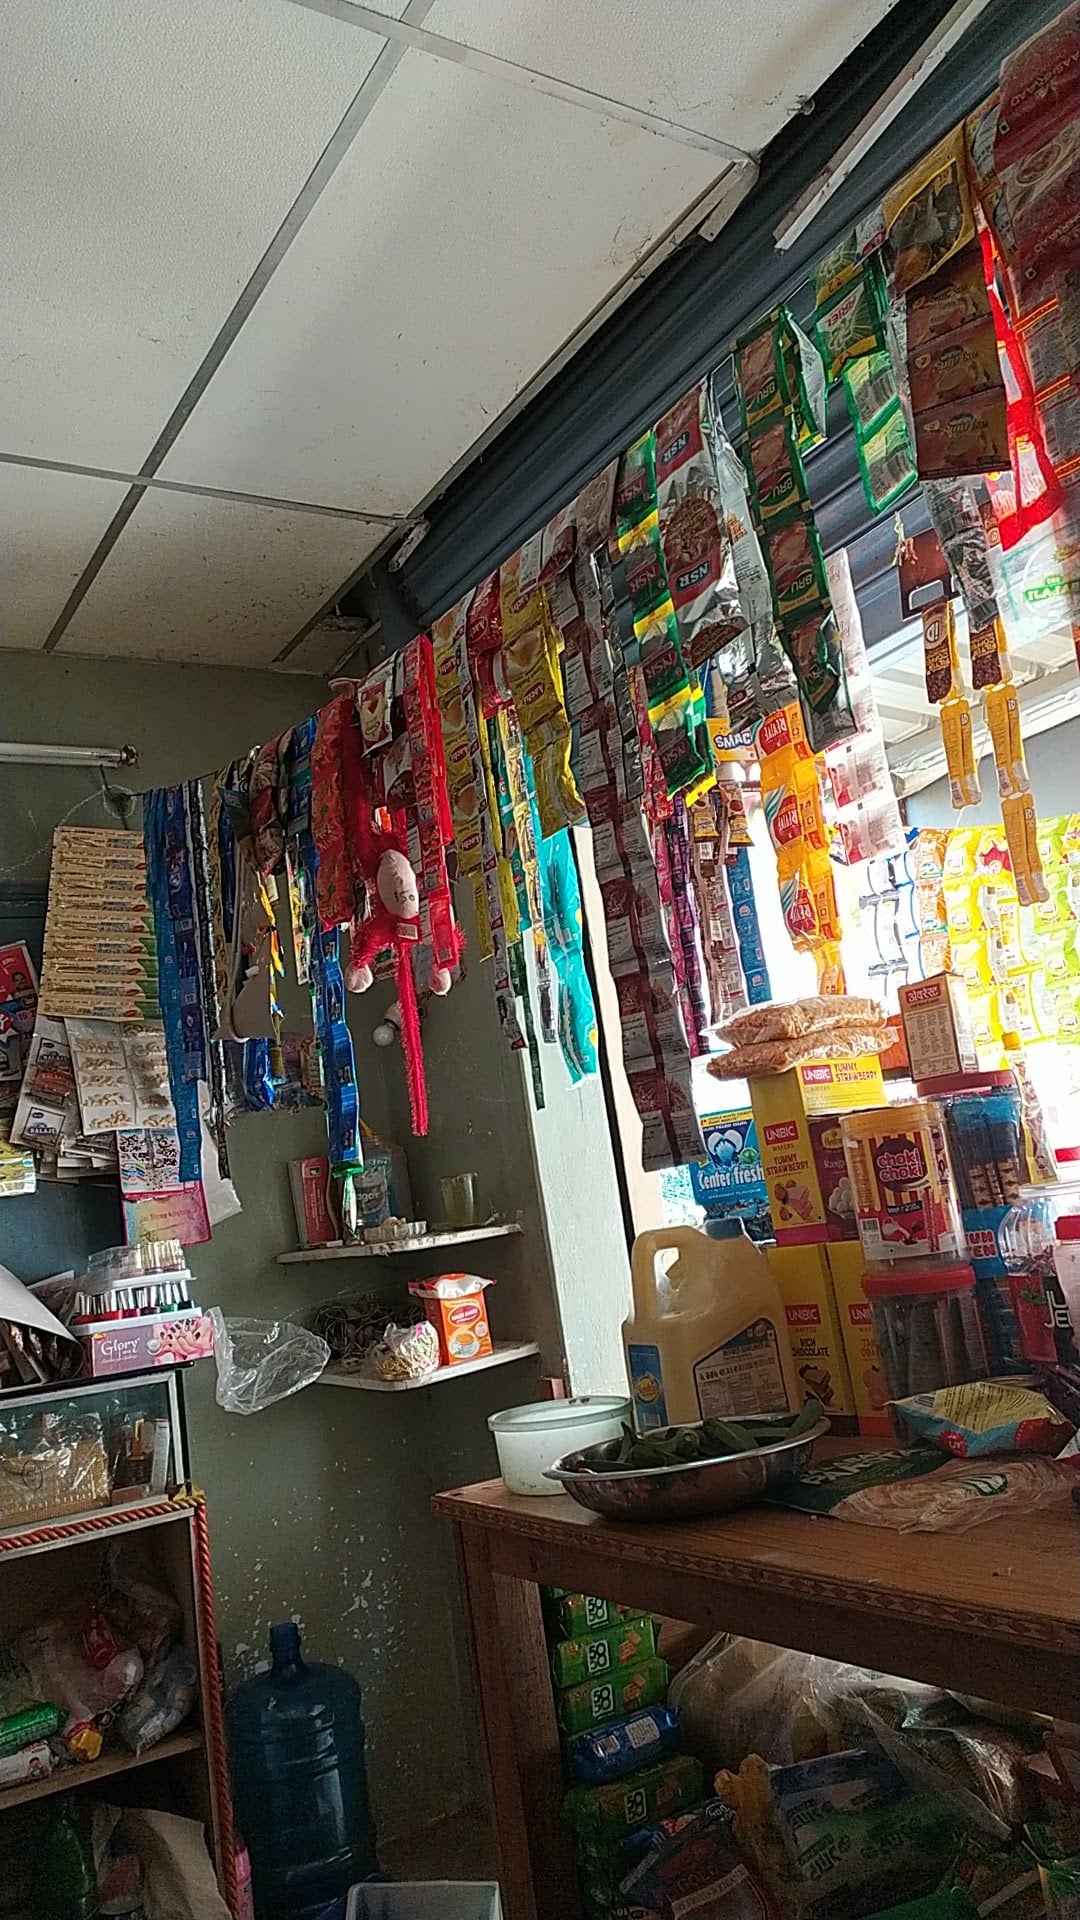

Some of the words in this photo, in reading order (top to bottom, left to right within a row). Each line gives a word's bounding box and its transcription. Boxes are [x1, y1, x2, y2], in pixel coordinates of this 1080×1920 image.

[1010, 51, 1080, 105] AASHIRVAAD
[825, 295, 856, 328] ARIEL
[756, 382, 775, 404] BRU
[661, 432, 688, 463] NSR
[772, 477, 793, 497] BRU
[630, 565, 655, 592] NSR
[678, 563, 709, 588] NSR
[790, 572, 813, 593] BRU
[645, 653, 674, 678] NSR
[521, 683, 544, 706] Aachi
[764, 717, 788, 738] REVIVE
[662, 742, 685, 767] NSR
[778, 808, 799, 831] REVIVE
[803, 1068, 831, 1081] UNIBIC
[834, 1063, 858, 1073] YUMMY
[836, 1071, 877, 1082] STRAWBERRY
[766, 1126, 796, 1141] UNIBIC
[766, 1160, 809, 1176] STRAWBERRY
[773, 1153, 798, 1164] YUMMY
[877, 1150, 921, 1168] choki
[698, 1170, 731, 1190] Center
[734, 1165, 765, 1184] fresh
[880, 1165, 923, 1181] choki
[788, 1308, 819, 1321] UNIBIC
[791, 1347, 830, 1357] CHOCOLATE
[800, 1338, 817, 1348] RICH
